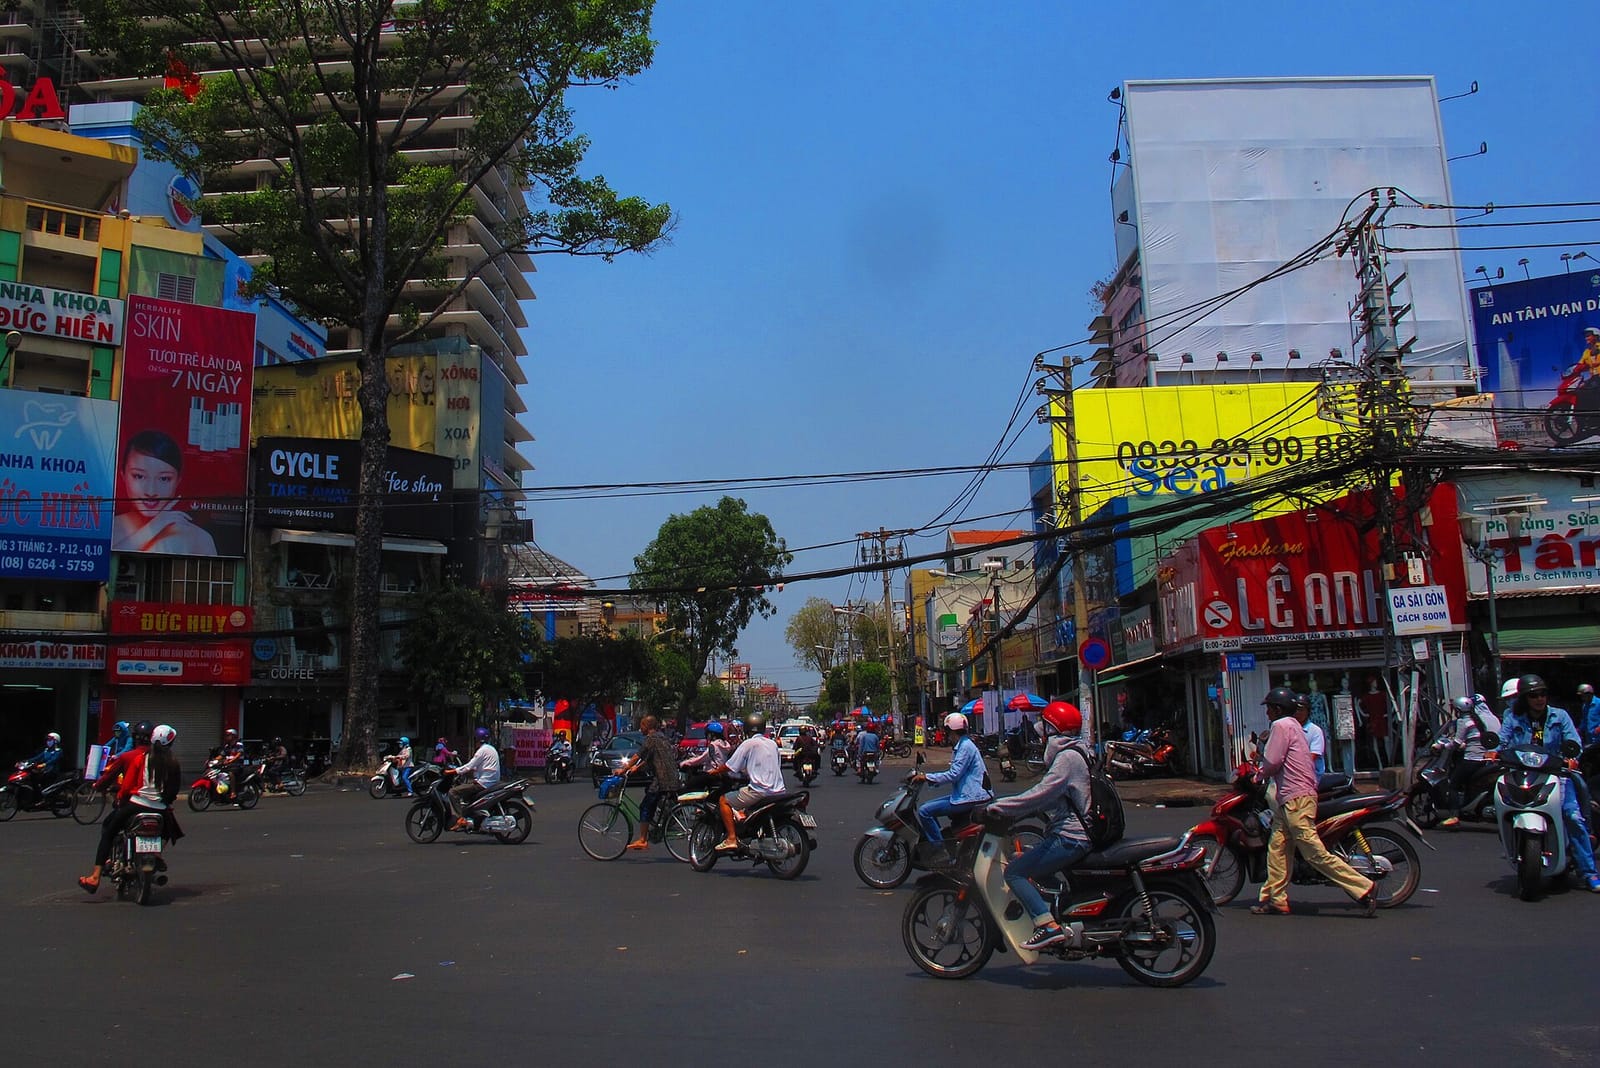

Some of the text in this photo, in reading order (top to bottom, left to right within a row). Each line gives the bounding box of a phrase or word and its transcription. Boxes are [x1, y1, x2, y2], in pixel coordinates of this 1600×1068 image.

[0, 283, 111, 315] NHA KHOA
[135, 303, 182, 316] HERBALIFE
[1492, 312, 1513, 326] AN
[1515, 306, 1548, 322] TÂM
[1550, 300, 1583, 317] VẠN
[0, 304, 114, 342] ĐỨC HIỀN
[133, 312, 182, 342] SKIN
[148, 348, 177, 364] TƯƠI
[201, 355, 225, 371] LÀN
[226, 359, 243, 373] DA
[441, 362, 479, 381] XÔNG
[171, 369, 184, 388] 7
[186, 371, 243, 395] NGÀY
[444, 428, 471, 440] XOA
[0, 454, 87, 474] NHA KHOA
[270, 449, 340, 480] CYCLE
[454, 455, 472, 470] ÓP
[267, 482, 308, 497] TAKE
[411, 474, 443, 502] shop
[1567, 511, 1599, 526] Sửa
[0, 539, 8, 551] G
[9, 540, 16, 552] 3
[17, 538, 46, 553] THÁNG
[46, 542, 53, 553] 2
[60, 543, 78, 554] P.12
[84, 544, 103, 557] Q.10
[1, 556, 23, 570] (08)
[27, 557, 56, 570] 6264
[66, 559, 95, 572] 5759
[1493, 575, 1511, 583] 128
[1513, 573, 1530, 582] Bis
[1236, 562, 1295, 630] LÊ
[1393, 595, 1406, 609] GA
[1425, 589, 1445, 606] GÒN
[140, 606, 229, 633] ĐỨC HUY
[1397, 611, 1420, 623] CÁCH
[271, 668, 315, 680] COFFEE
